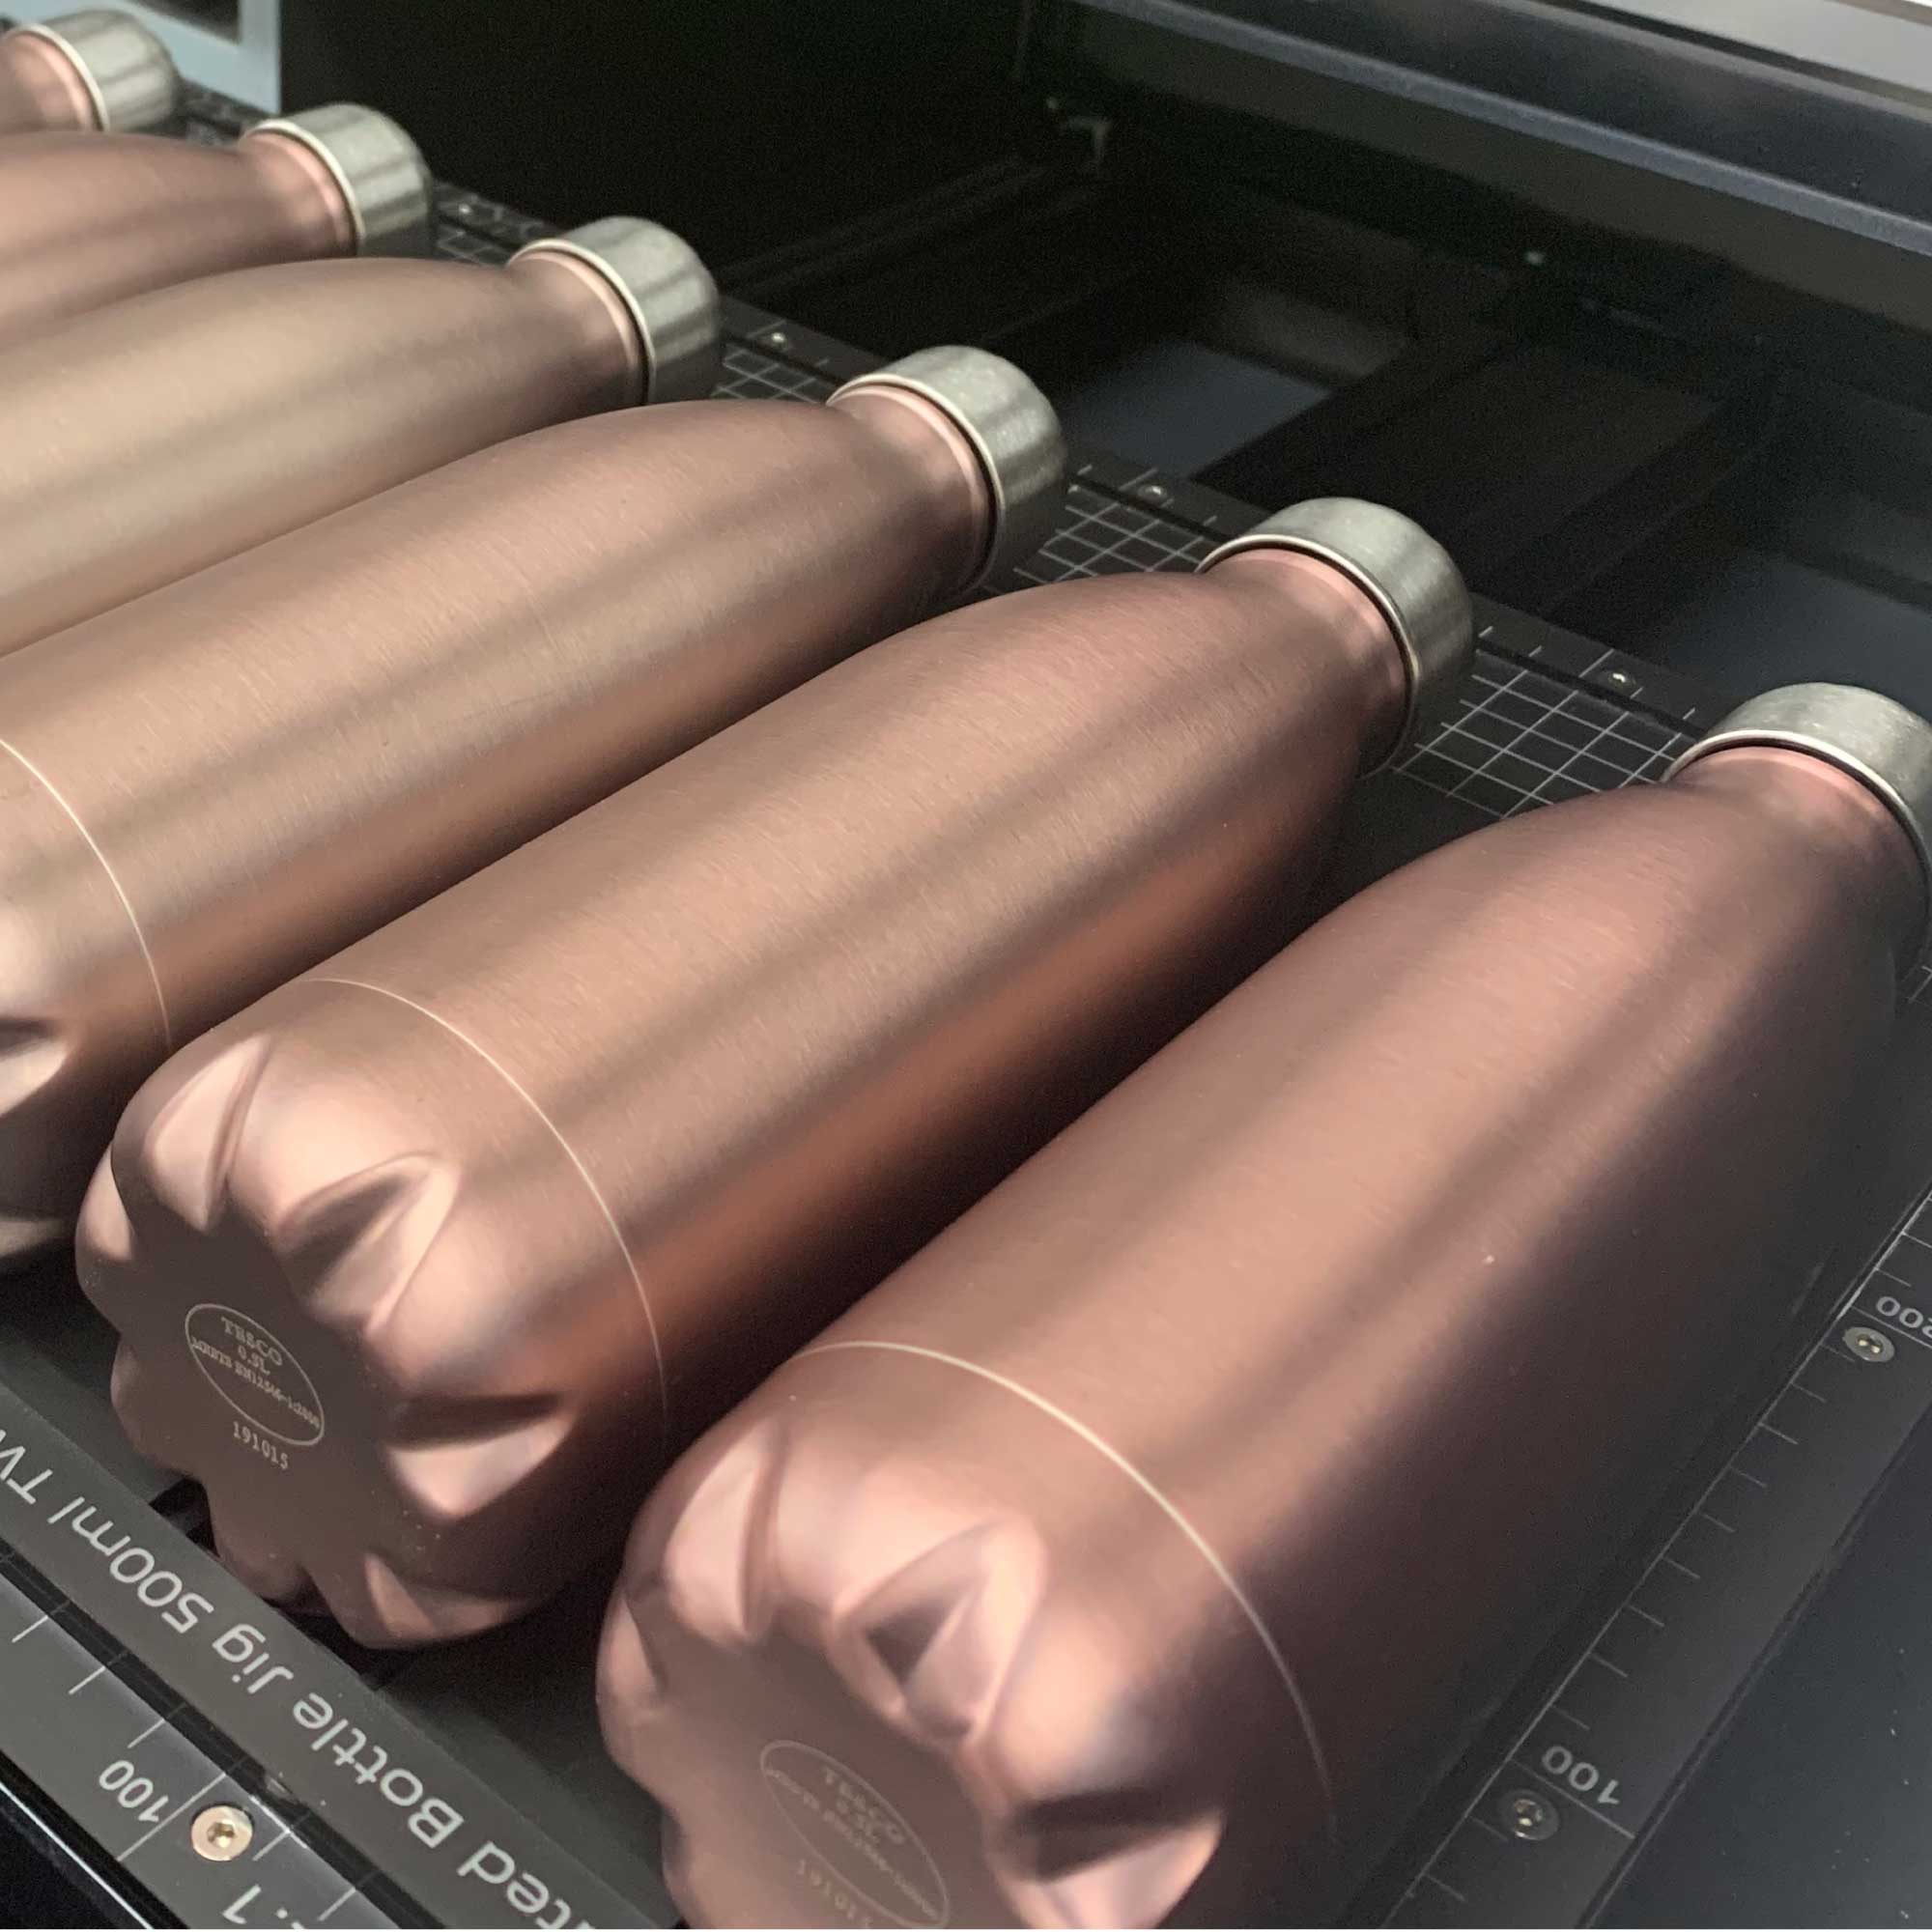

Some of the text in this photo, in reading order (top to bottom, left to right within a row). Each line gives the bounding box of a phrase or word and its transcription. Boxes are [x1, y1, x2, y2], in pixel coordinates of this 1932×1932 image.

[232, 1421, 289, 1470] 191015
[47, 1496, 214, 1634] 500ml
[212, 1623, 294, 1694] Jig
[99, 1760, 170, 1824] 100
[293, 1692, 465, 1849] Bottle
[1541, 1746, 1620, 1805] 100
